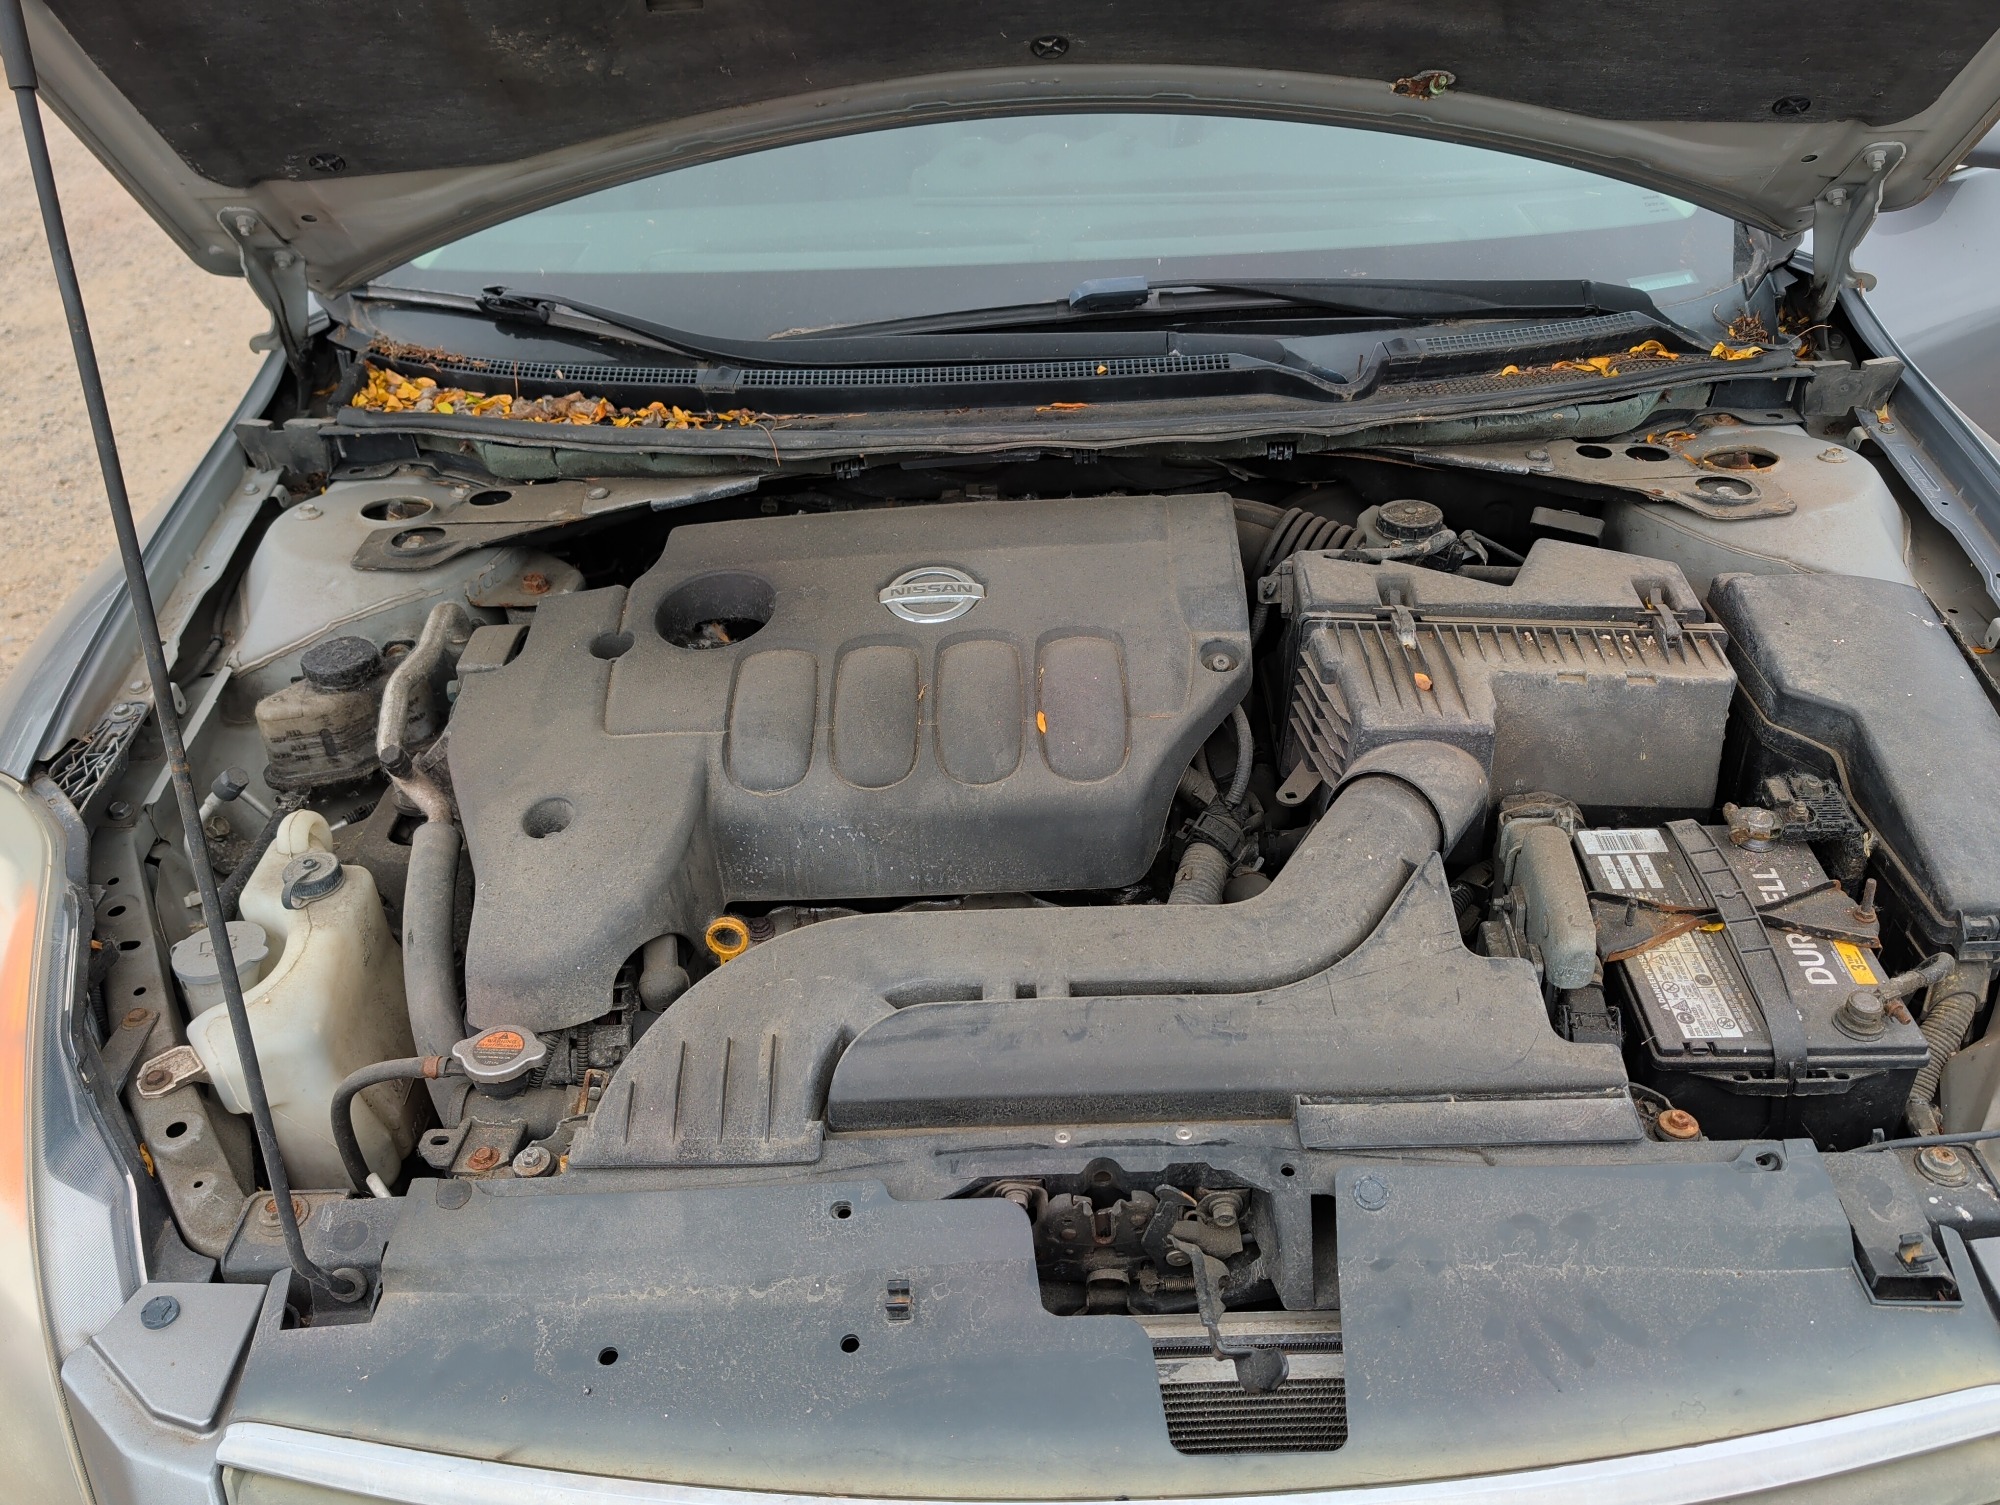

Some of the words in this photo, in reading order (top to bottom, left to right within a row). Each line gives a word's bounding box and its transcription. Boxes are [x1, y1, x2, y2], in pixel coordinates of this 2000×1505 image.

[890, 584, 973, 597] NISSAN
[1752, 867, 1838, 985] DURELL
[1851, 963, 1867, 971] 3
